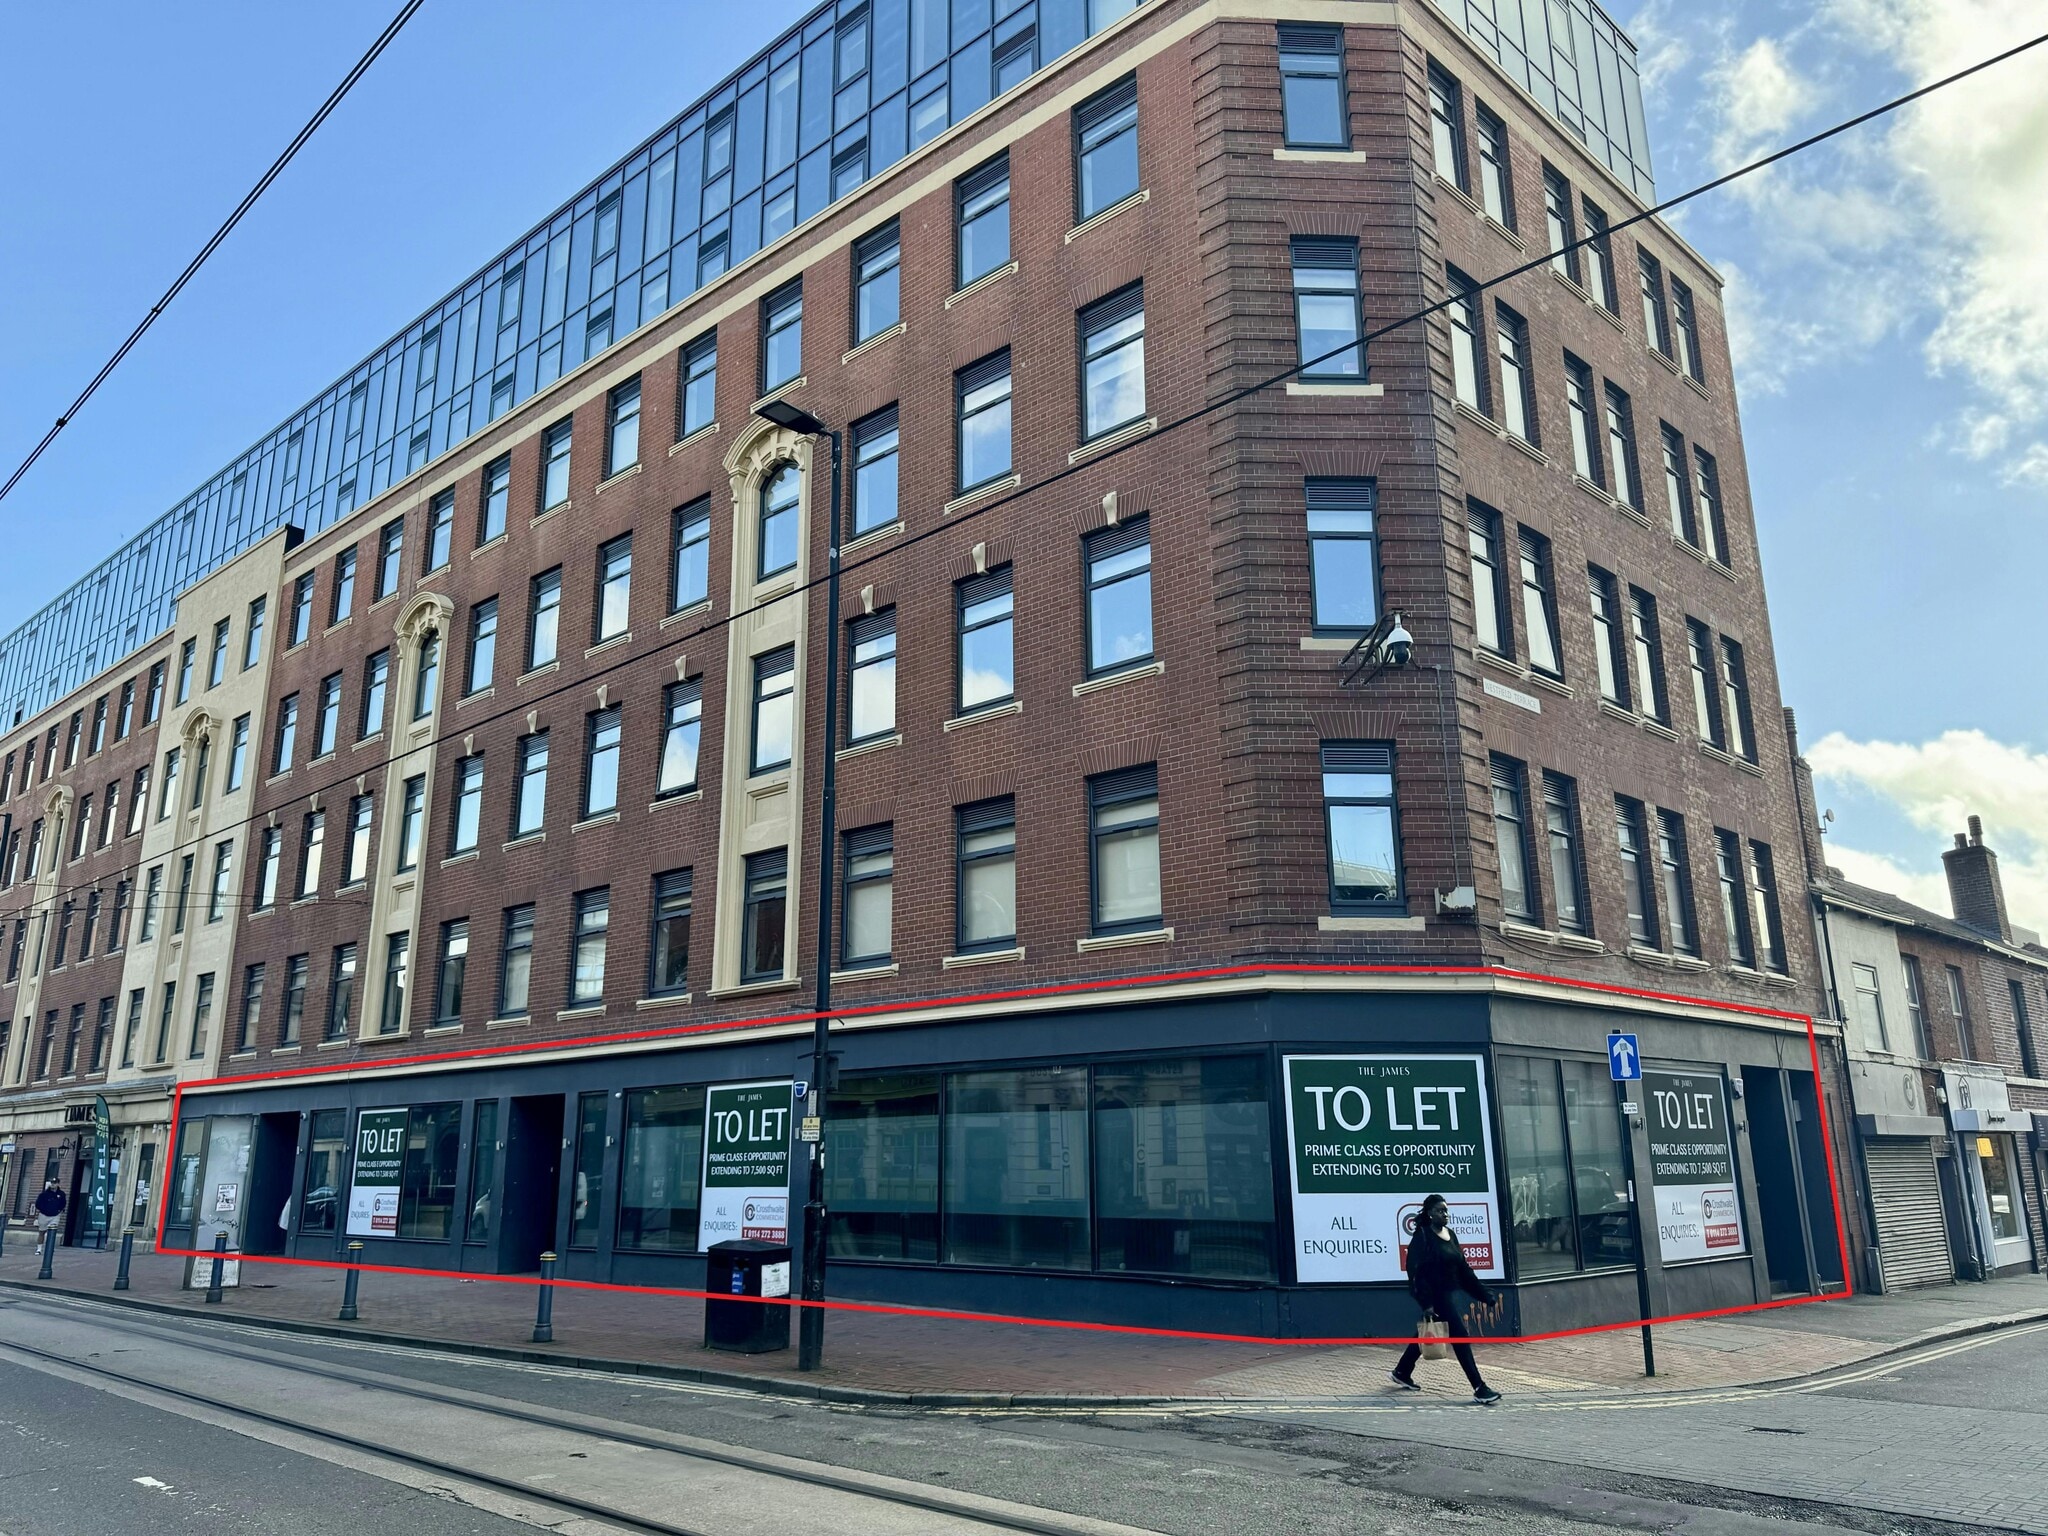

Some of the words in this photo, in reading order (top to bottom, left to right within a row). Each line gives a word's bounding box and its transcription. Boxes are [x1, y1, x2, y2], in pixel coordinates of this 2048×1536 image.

[1358, 1066, 1375, 1076] THE
[1380, 1066, 1410, 1078] JAMES
[1304, 1085, 1372, 1132] TO
[1386, 1086, 1466, 1131] LET
[1653, 1091, 1682, 1130] TO
[1684, 1092, 1713, 1130] LET
[714, 1109, 742, 1143] TO
[748, 1108, 788, 1142] LET
[362, 1129, 378, 1154] TO
[380, 1128, 404, 1153] LET
[1305, 1144, 1342, 1157] PRIME
[1344, 1144, 1381, 1157] CLASS
[1384, 1144, 1391, 1156] E
[1393, 1144, 1476, 1157] OPPORTUNITY
[1651, 1143, 1670, 1156] PRIME
[1670, 1143, 1687, 1156] CLASS
[1688, 1144, 1692, 1155] E
[1692, 1144, 1727, 1156] OPPORTUNITY
[709, 1153, 726, 1162] PRIME
[726, 1152, 743, 1162] CLASS
[747, 1152, 787, 1161] OPPORTUNITY
[711, 1166, 742, 1175] EXTENDING
[743, 1166, 750, 1175] TO
[750, 1165, 766, 1175] 7,500
[766, 1165, 776, 1176] SQ
[776, 1165, 784, 1174] FT
[1312, 1163, 1382, 1176] EXTENDING
[1384, 1163, 1400, 1176] TO
[1402, 1163, 1435, 1177] 7,500
[1438, 1163, 1456, 1178] SQ
[1458, 1163, 1472, 1176] FT
[1656, 1162, 1689, 1175] EXTENDING
[1689, 1162, 1697, 1174] TO
[1697, 1162, 1712, 1175] 7,500
[1712, 1162, 1721, 1176] SQ
[1721, 1162, 1727, 1173] FT
[716, 1206, 726, 1216] ALL
[1672, 1202, 1685, 1216] ALL
[1331, 1216, 1358, 1230] ALL
[1450, 1213, 1484, 1224] thwaite
[704, 1220, 738, 1232] ENQUIRIES:
[1453, 1226, 1485, 1234] ERCIAL
[761, 1229, 771, 1238] 272
[1661, 1224, 1700, 1243] ENQUIRIES:
[1303, 1240, 1388, 1258] ENQUIRIES:
[1463, 1248, 1489, 1258] 3888
